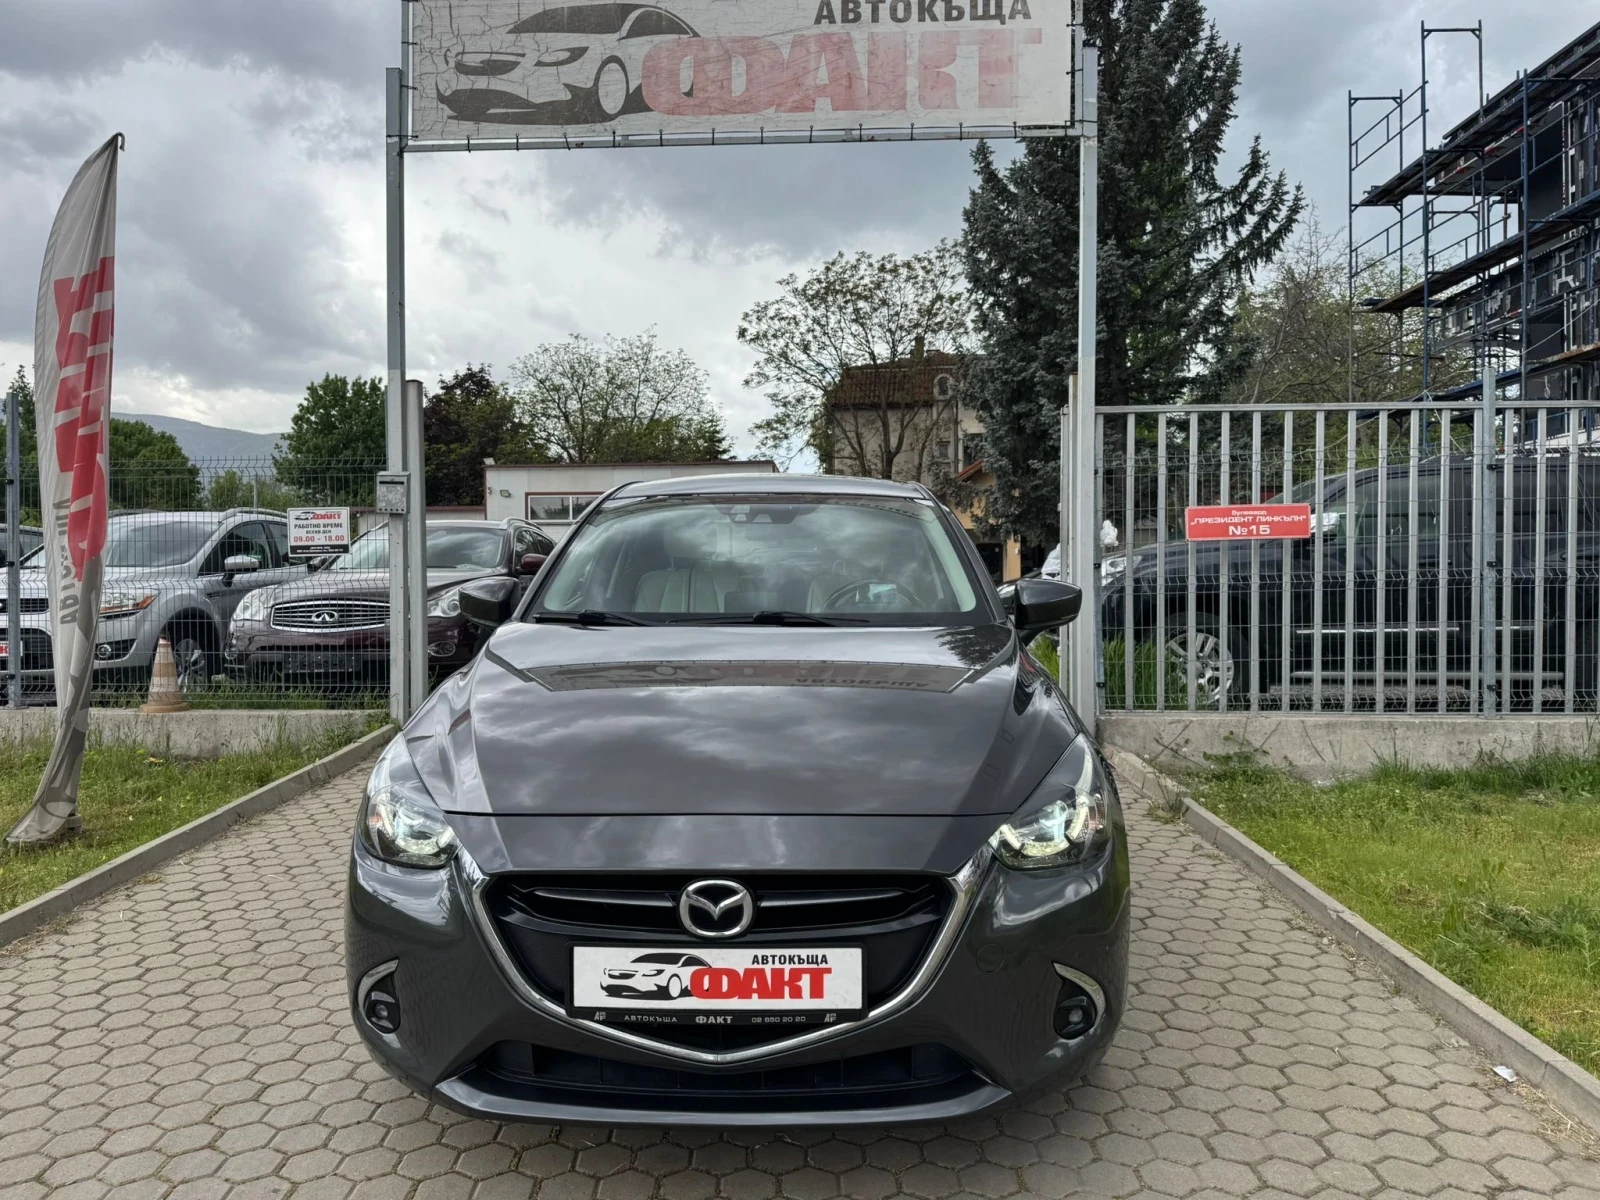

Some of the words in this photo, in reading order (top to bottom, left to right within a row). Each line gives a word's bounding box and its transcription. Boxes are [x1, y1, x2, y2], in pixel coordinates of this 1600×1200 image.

[813, 0, 1032, 25] АВТОКЪЩА
[641, 28, 1042, 116] ФАКТ
[324, 534, 345, 542] 18.00
[752, 954, 828, 965] АВТОКЪЩА
[690, 967, 832, 1000] ФАКТ
[695, 1015, 733, 1024] ФАКТ
